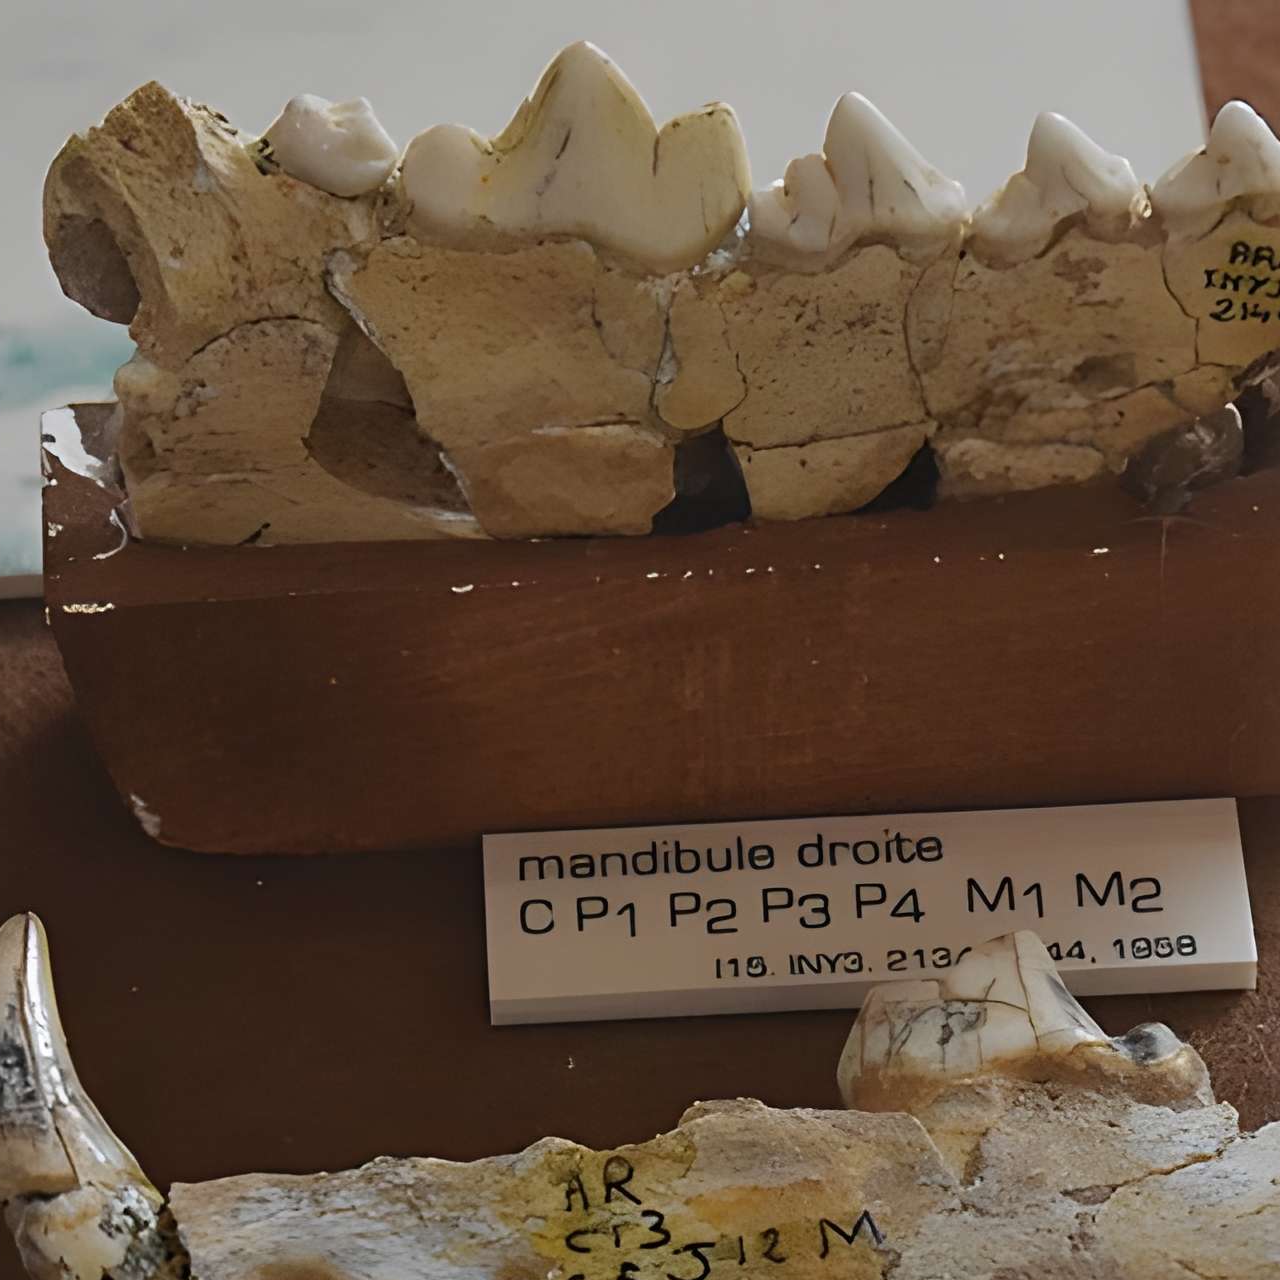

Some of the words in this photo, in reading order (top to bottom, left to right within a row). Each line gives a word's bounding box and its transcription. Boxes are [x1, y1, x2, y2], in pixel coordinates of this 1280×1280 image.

[518, 834, 776, 883] mandibule
[797, 829, 945, 868] droite
[519, 898, 555, 936] C
[575, 895, 638, 938] P1
[669, 891, 740, 935] P2
[761, 886, 833, 930] P3
[854, 882, 926, 924] P4
[966, 875, 1045, 919] M1
[1074, 870, 1165, 914] M2
